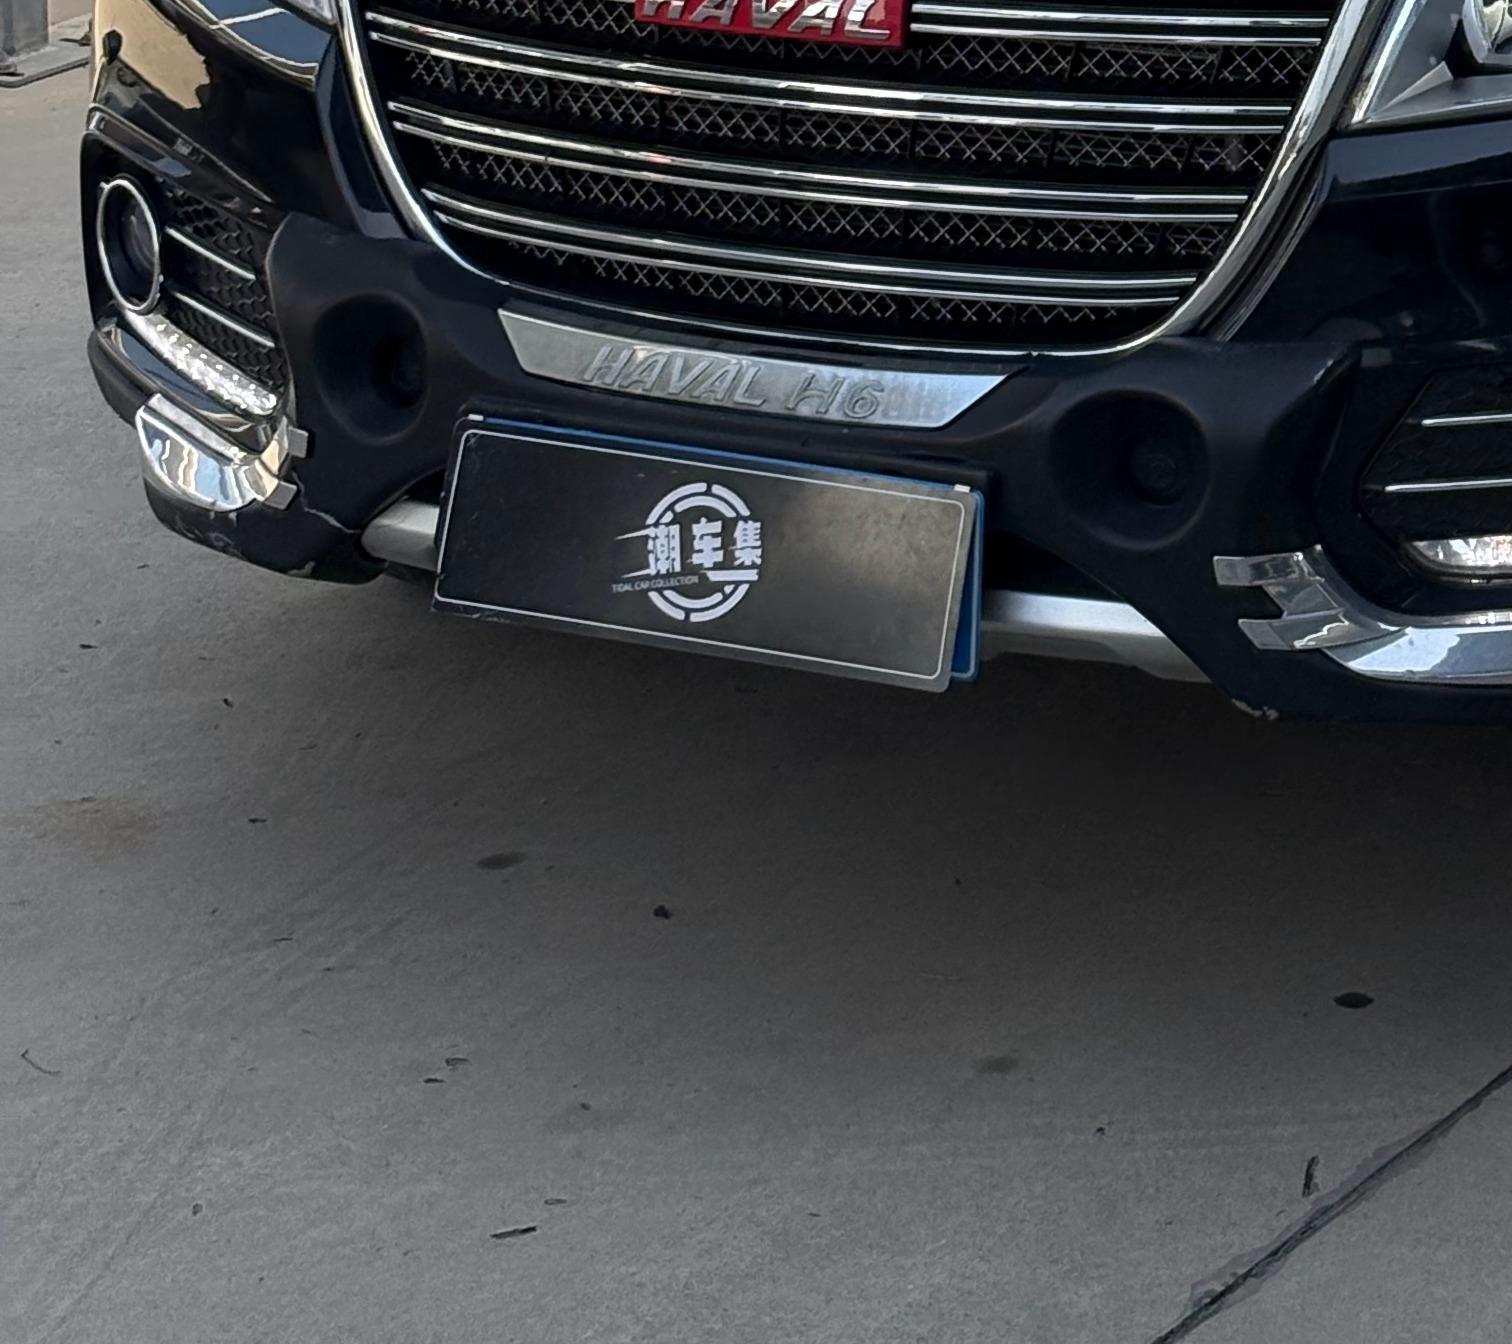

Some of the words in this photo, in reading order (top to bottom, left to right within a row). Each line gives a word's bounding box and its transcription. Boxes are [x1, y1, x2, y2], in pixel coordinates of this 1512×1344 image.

[583, 344, 767, 408] HAVAL
[785, 370, 886, 419] H6
[647, 516, 762, 576] 潮车集
